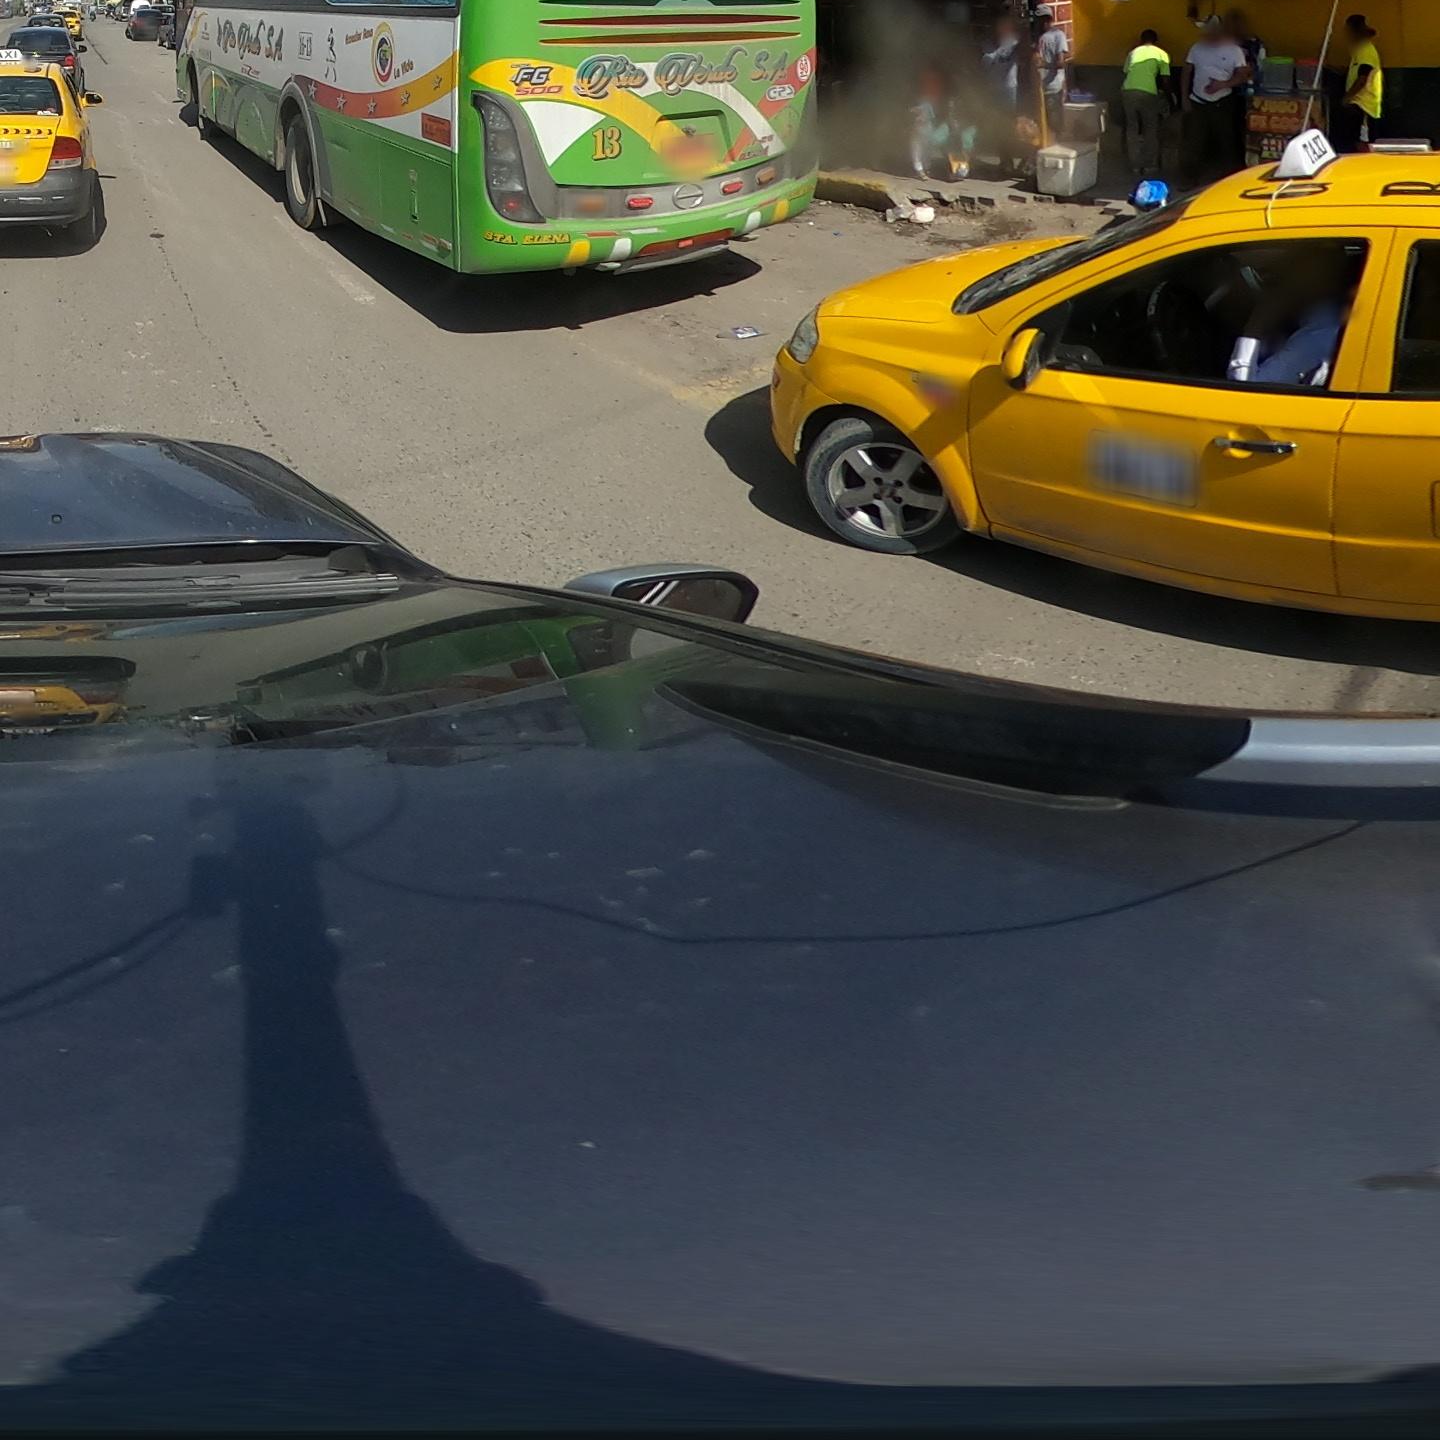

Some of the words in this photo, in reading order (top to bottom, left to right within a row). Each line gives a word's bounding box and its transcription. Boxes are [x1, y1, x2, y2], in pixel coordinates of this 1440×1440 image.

[0, 50, 13, 59] XI
[592, 126, 623, 161] 13
[1302, 135, 1328, 165] TAXI
